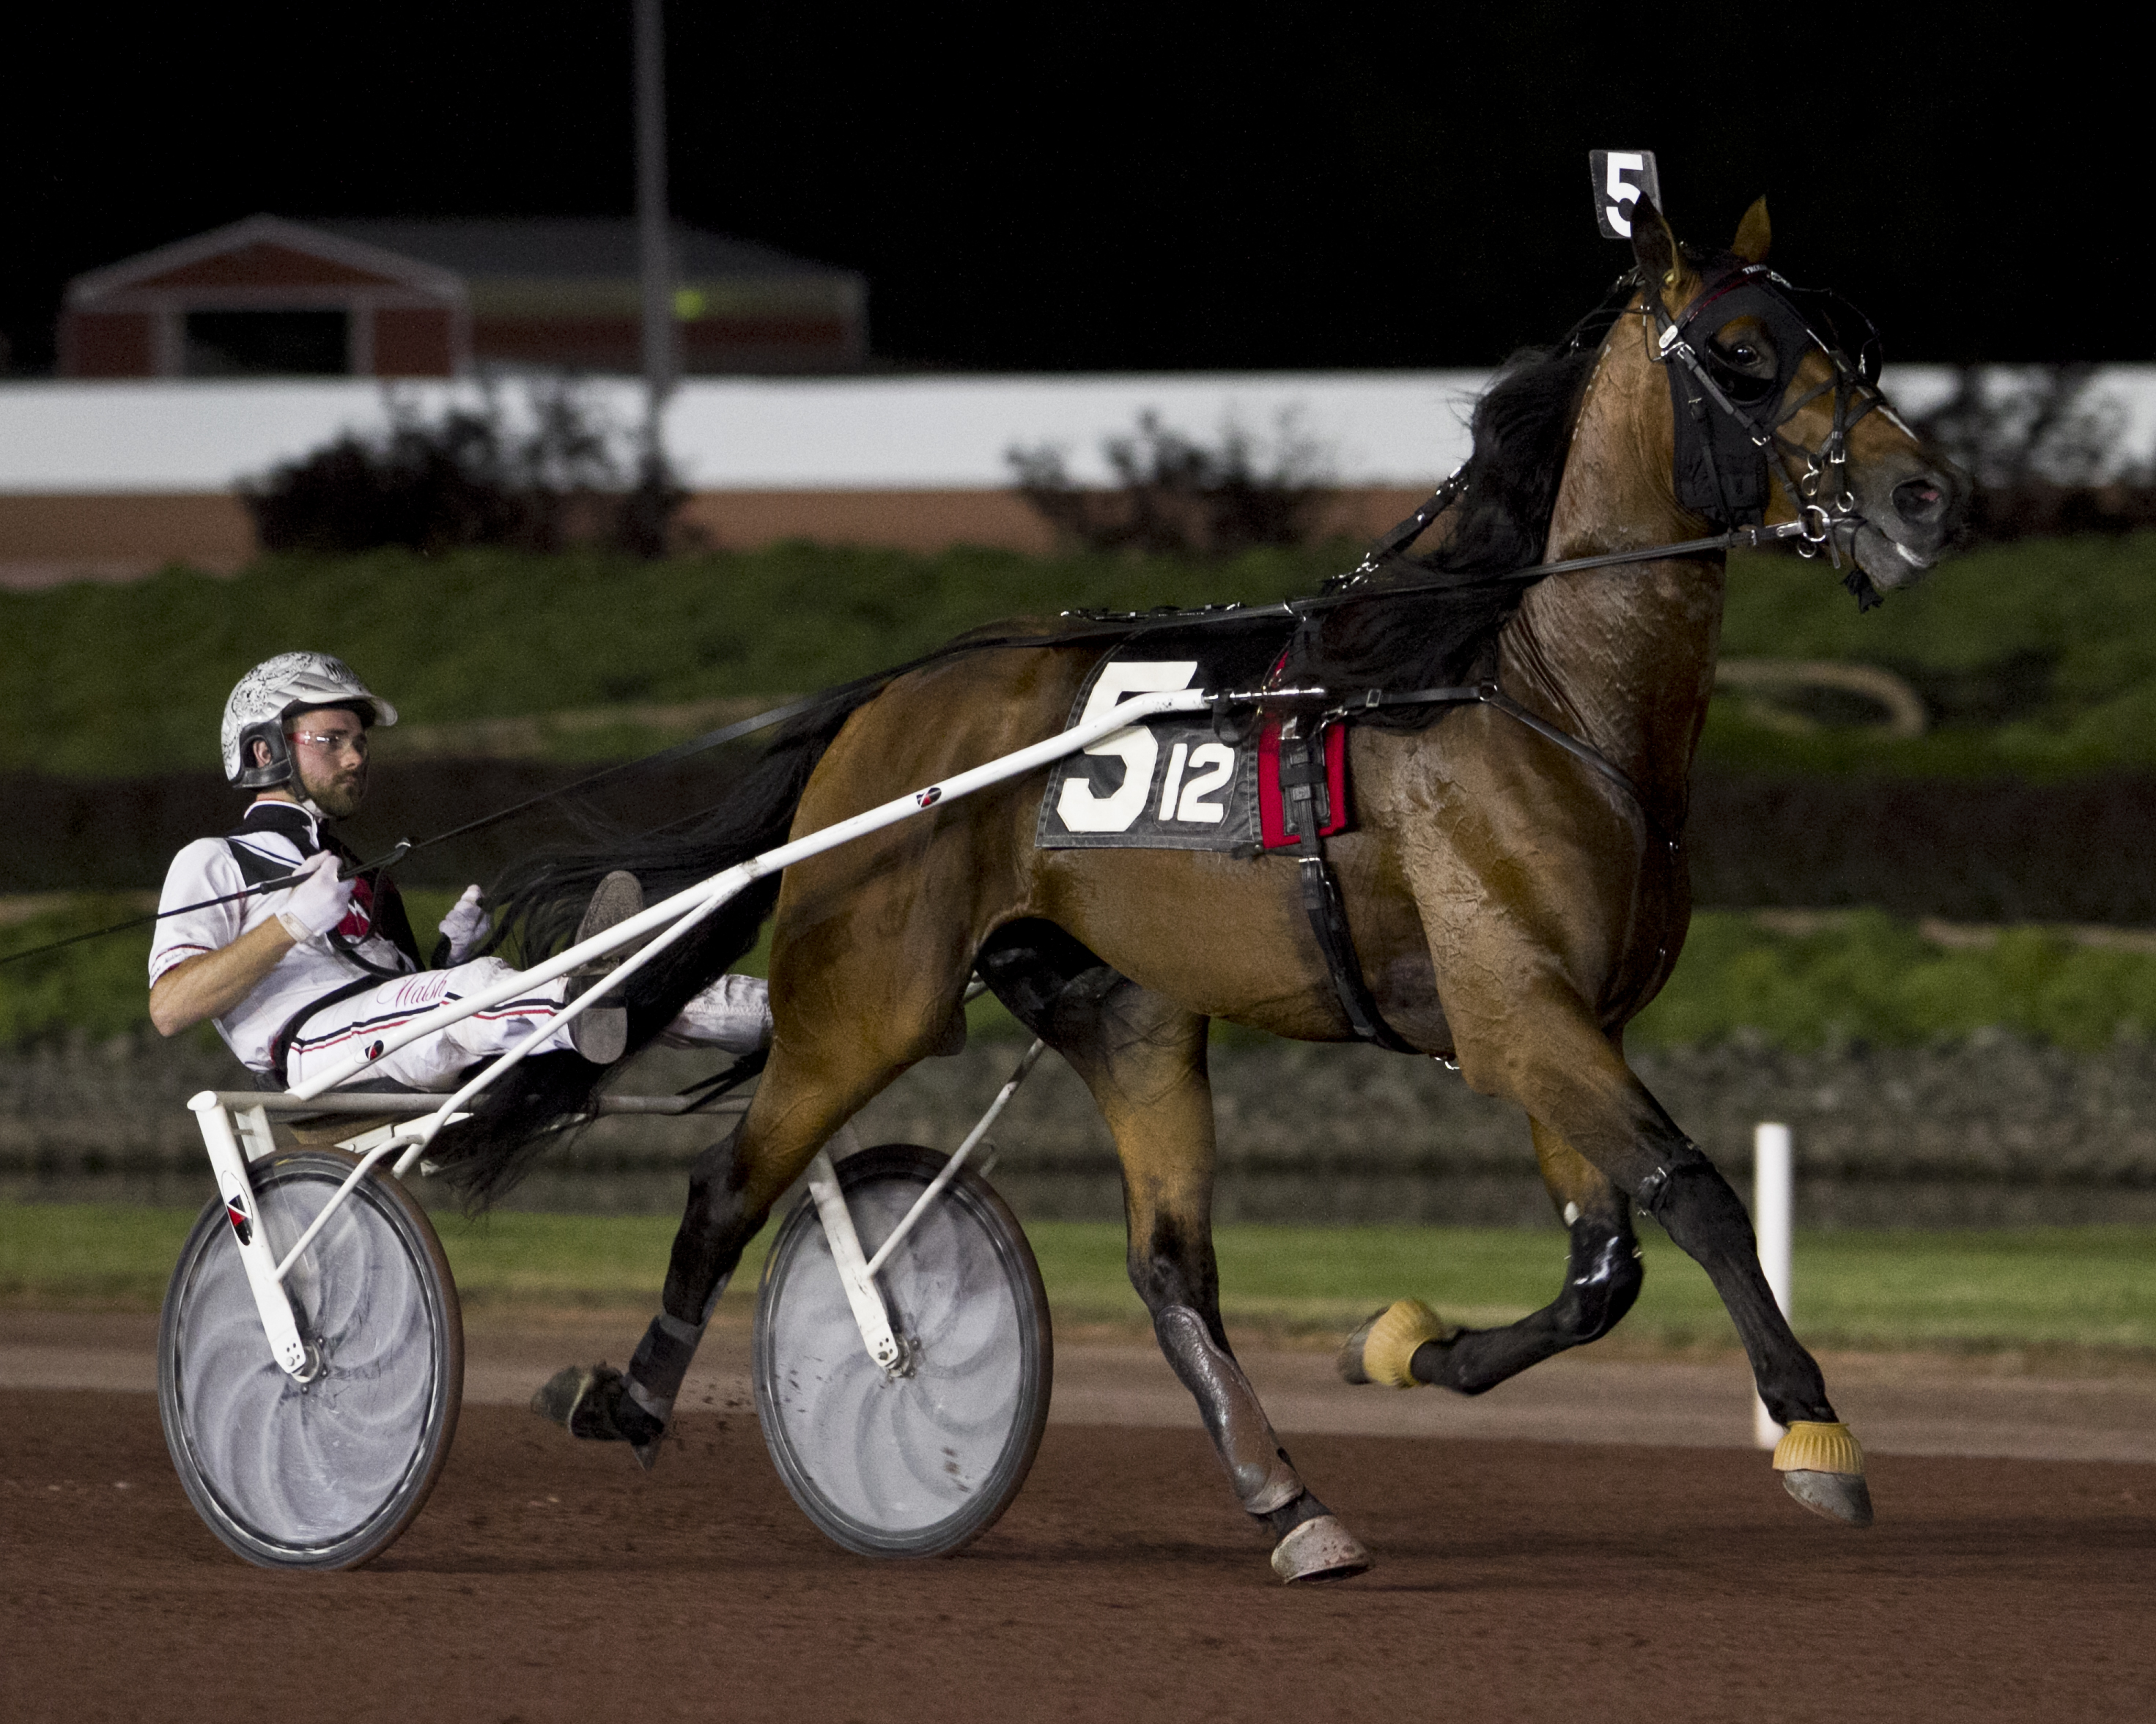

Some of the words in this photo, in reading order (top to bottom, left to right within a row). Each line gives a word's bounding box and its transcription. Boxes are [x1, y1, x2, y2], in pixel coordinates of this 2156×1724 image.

[1606, 152, 1643, 237] 5
[1057, 662, 1197, 832] 5
[1159, 743, 1235, 823] 12
